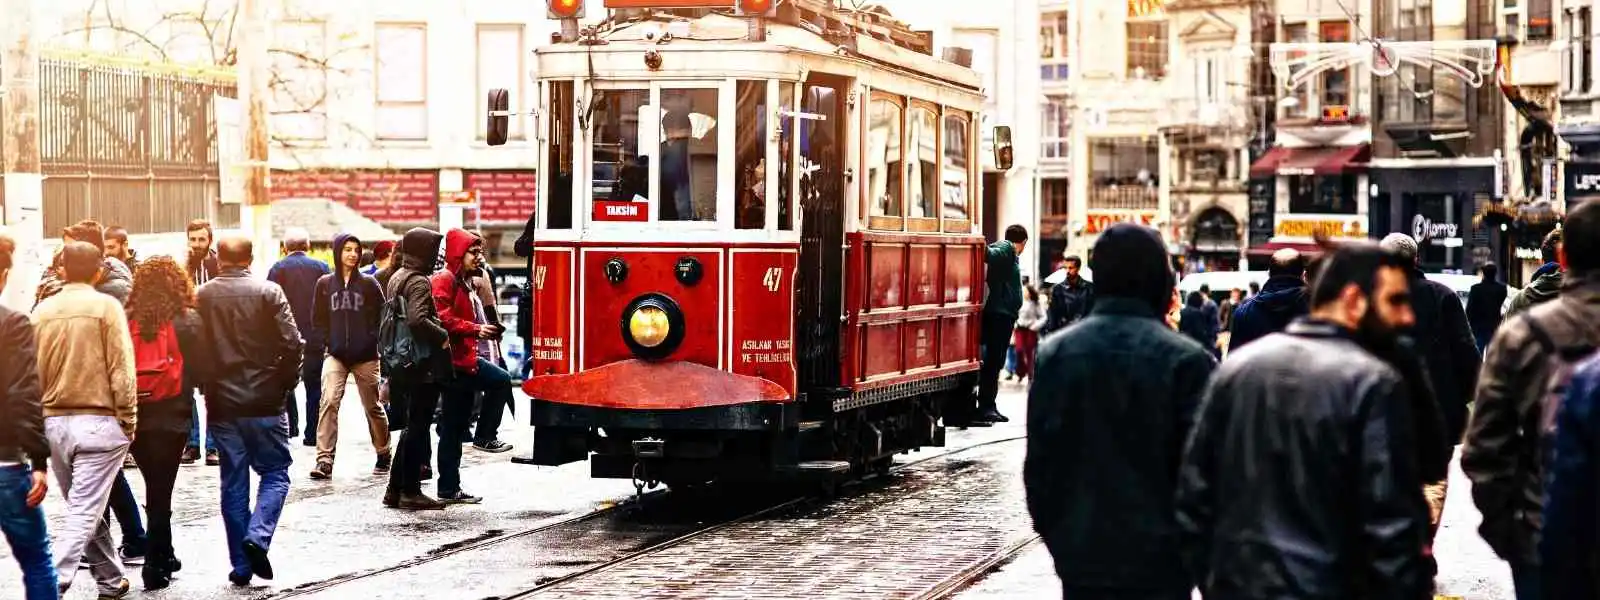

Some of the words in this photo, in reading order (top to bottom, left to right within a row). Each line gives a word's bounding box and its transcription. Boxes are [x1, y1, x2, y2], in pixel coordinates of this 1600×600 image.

[763, 266, 782, 292] 47
[331, 290, 365, 312] GAP
[742, 353, 752, 363] VE
